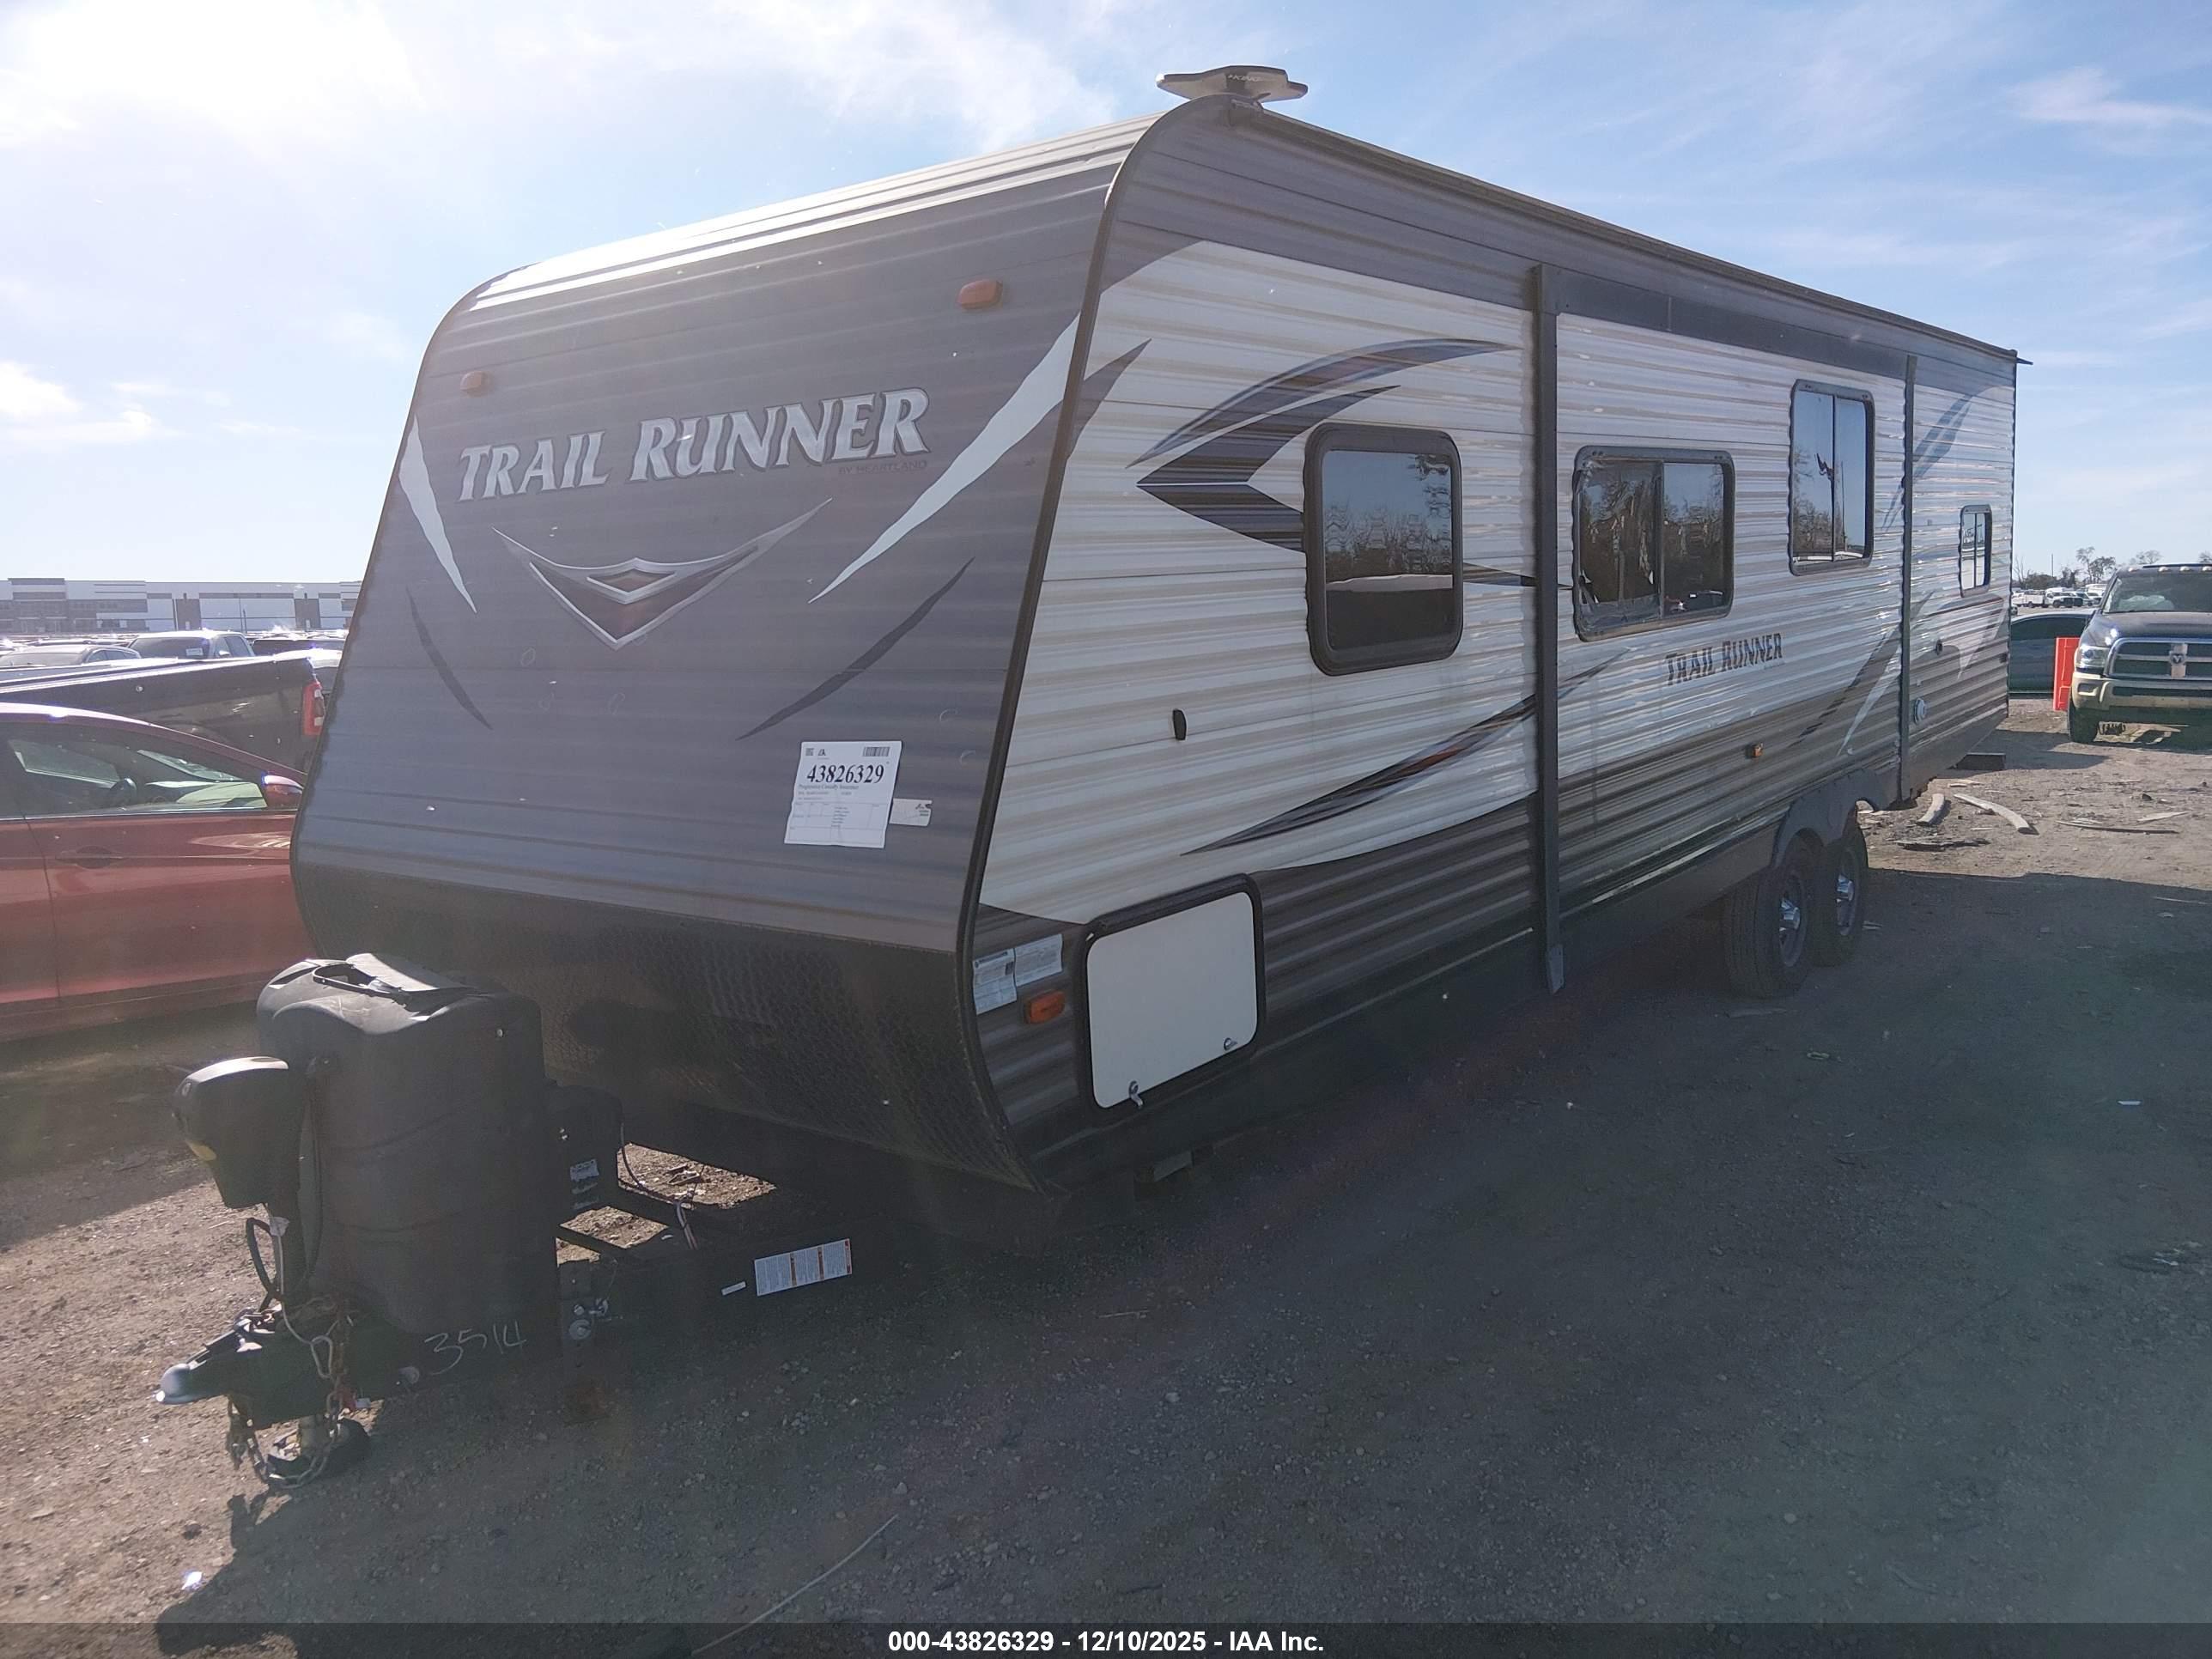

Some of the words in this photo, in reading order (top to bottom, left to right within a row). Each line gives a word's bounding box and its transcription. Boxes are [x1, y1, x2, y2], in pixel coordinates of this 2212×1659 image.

[456, 431, 611, 502] TRAIL
[627, 386, 932, 483] RUNNER
[1665, 646, 1717, 686] TRAIL
[1721, 632, 1783, 672] RUNNER
[806, 764, 884, 783] 43826329
